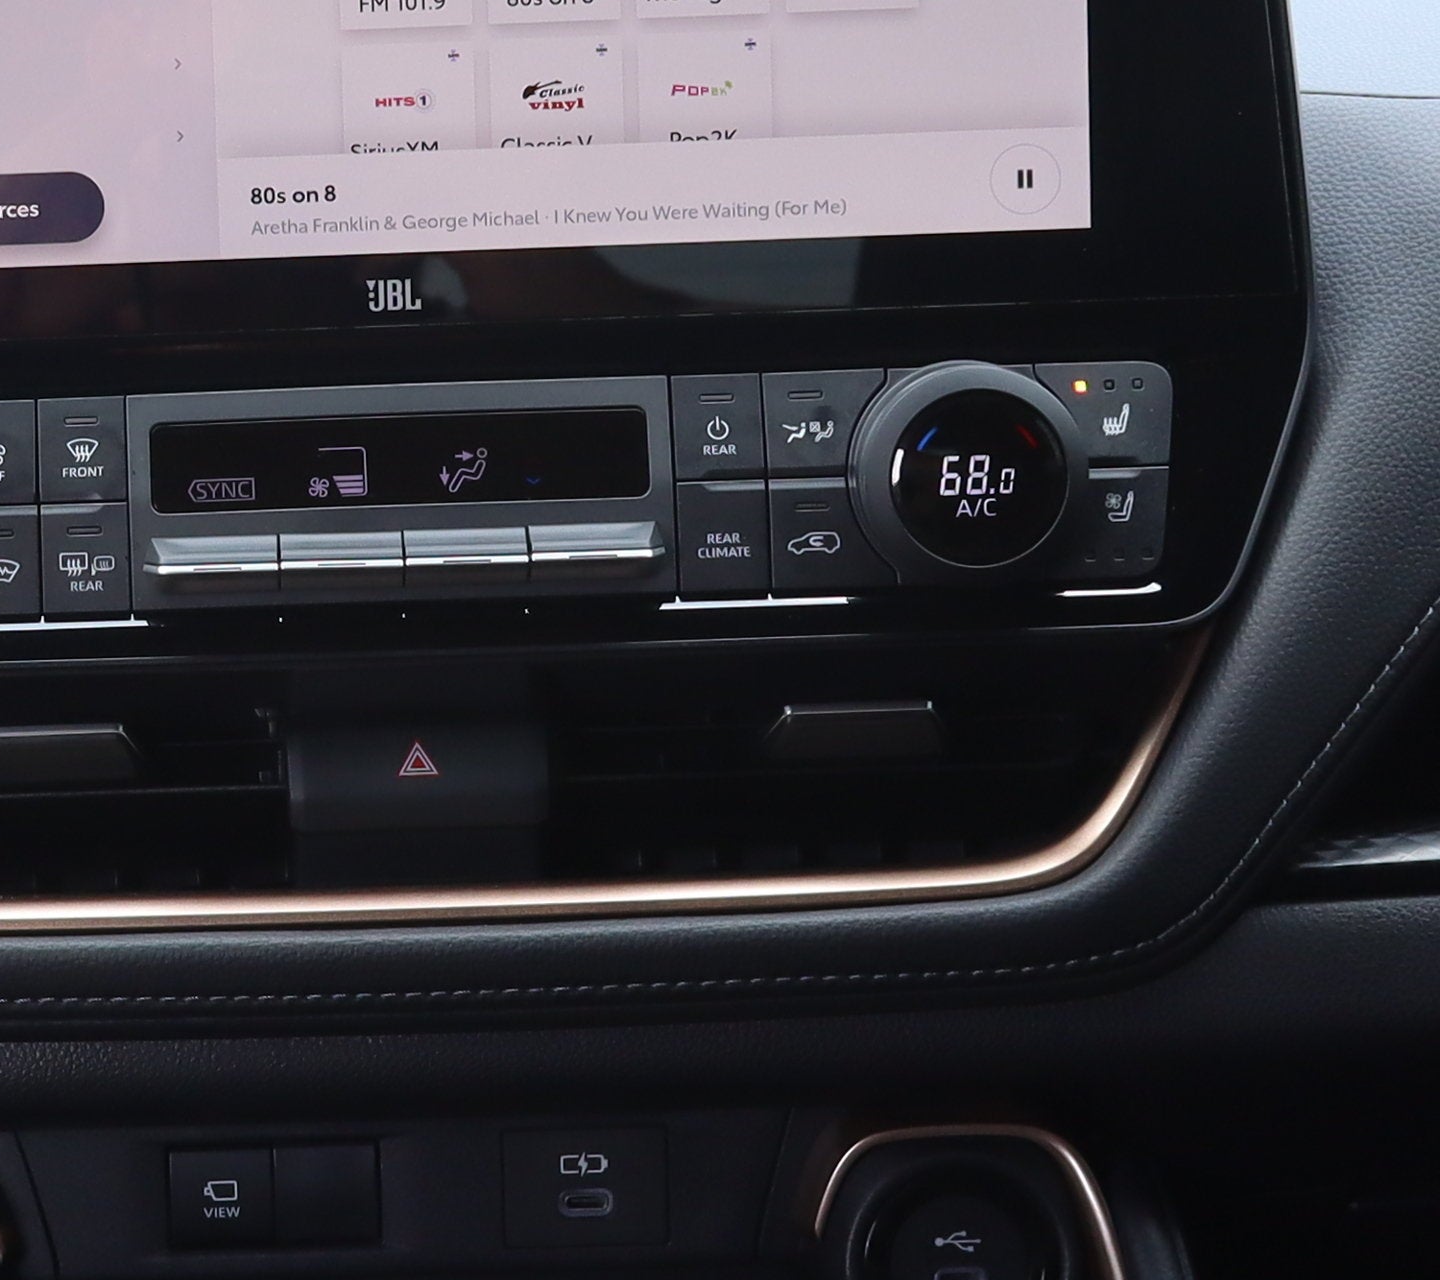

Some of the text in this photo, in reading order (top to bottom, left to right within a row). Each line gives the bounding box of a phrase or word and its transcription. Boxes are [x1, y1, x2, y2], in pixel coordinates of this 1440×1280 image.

[538, 84, 585, 98] Classic
[374, 96, 416, 108] HITS
[528, 98, 585, 112] vinyl
[250, 184, 337, 205] 80s on 8
[251, 218, 308, 236] Aretha
[313, 215, 379, 234] Franklin
[383, 215, 398, 230] &
[402, 213, 468, 232] George
[472, 209, 540, 228] Michael
[564, 208, 611, 224] Knew
[615, 206, 648, 222] You
[652, 204, 699, 220] Were
[703, 201, 769, 221] Waiting
[774, 199, 808, 218] (For
[813, 198, 848, 217] Me)
[366, 277, 422, 313] JBL
[702, 443, 737, 456] REAR
[61, 465, 105, 479] FRONT
[938, 454, 1016, 497] 68.0
[195, 481, 251, 499] SYNC
[955, 497, 998, 518] A/C
[706, 532, 741, 545] REAR
[697, 545, 751, 559] CLIMATE
[69, 579, 104, 592] REAR
[203, 1206, 241, 1219] VIEW
